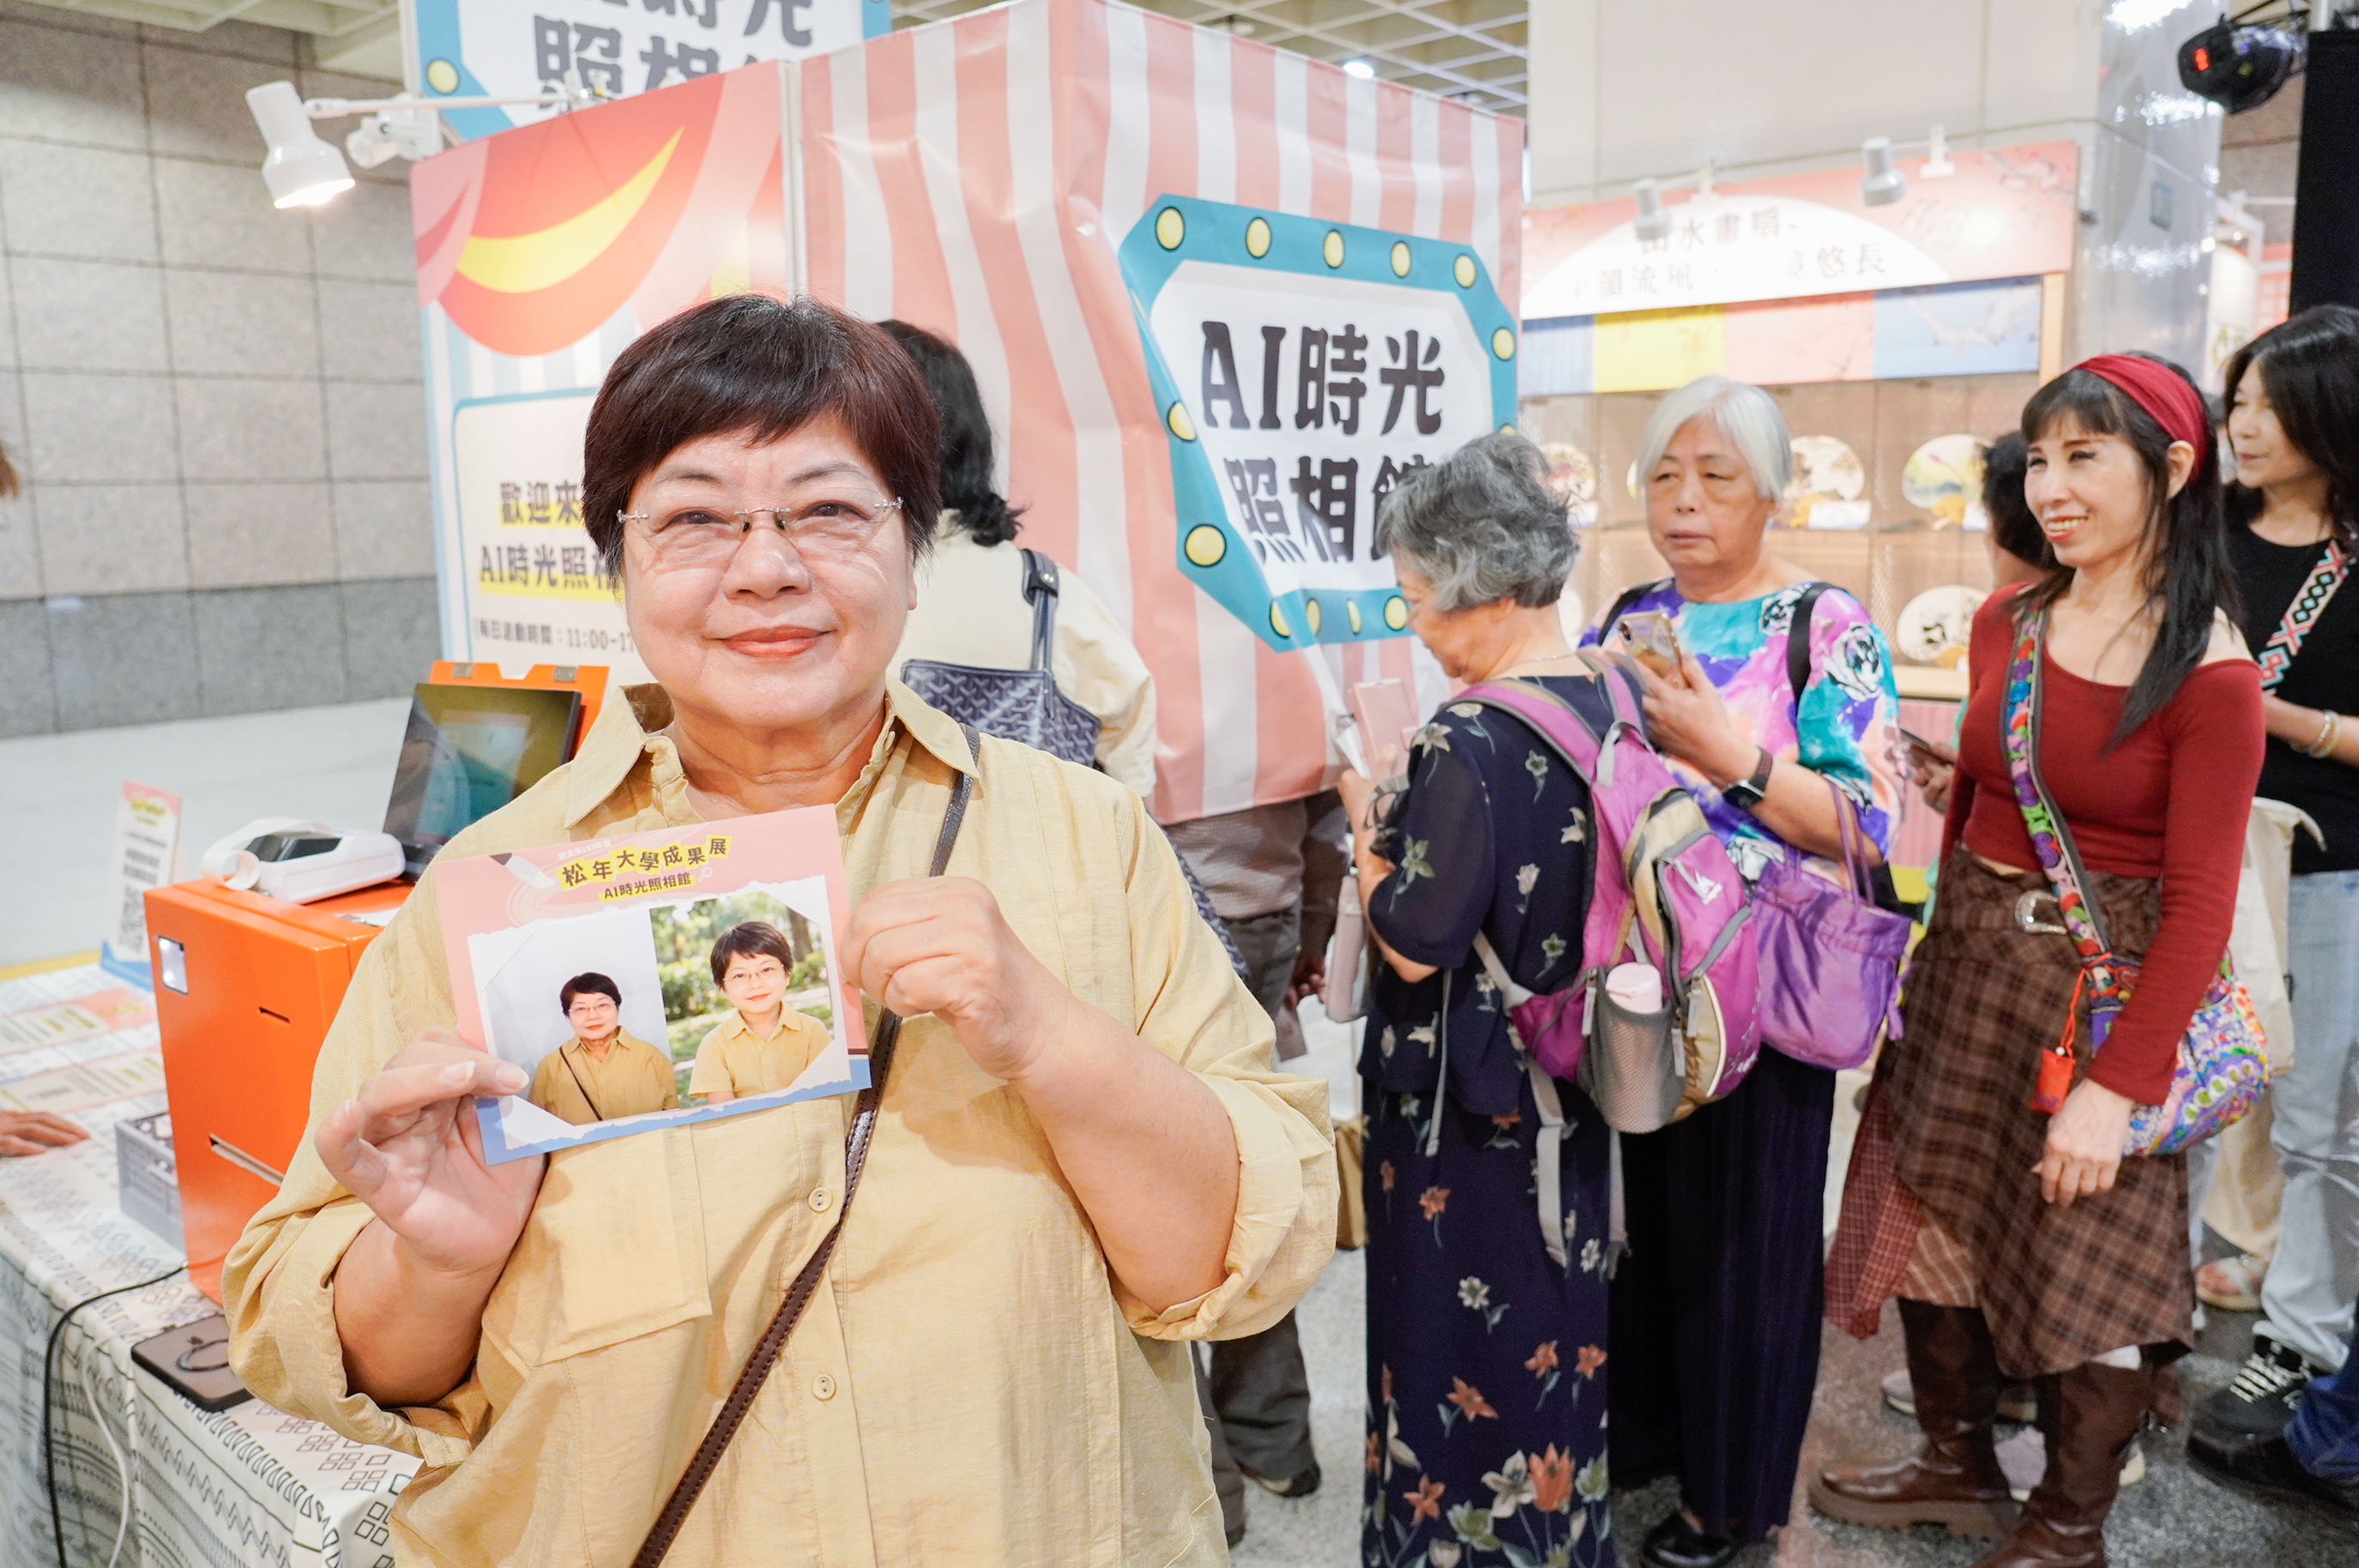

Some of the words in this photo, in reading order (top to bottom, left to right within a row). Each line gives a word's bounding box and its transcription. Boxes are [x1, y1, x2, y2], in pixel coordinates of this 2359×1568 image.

[1201, 320, 1445, 436] AI時光
[562, 838, 727, 887] 松年大學成果展
[604, 872, 691, 900] AI時光照相館
